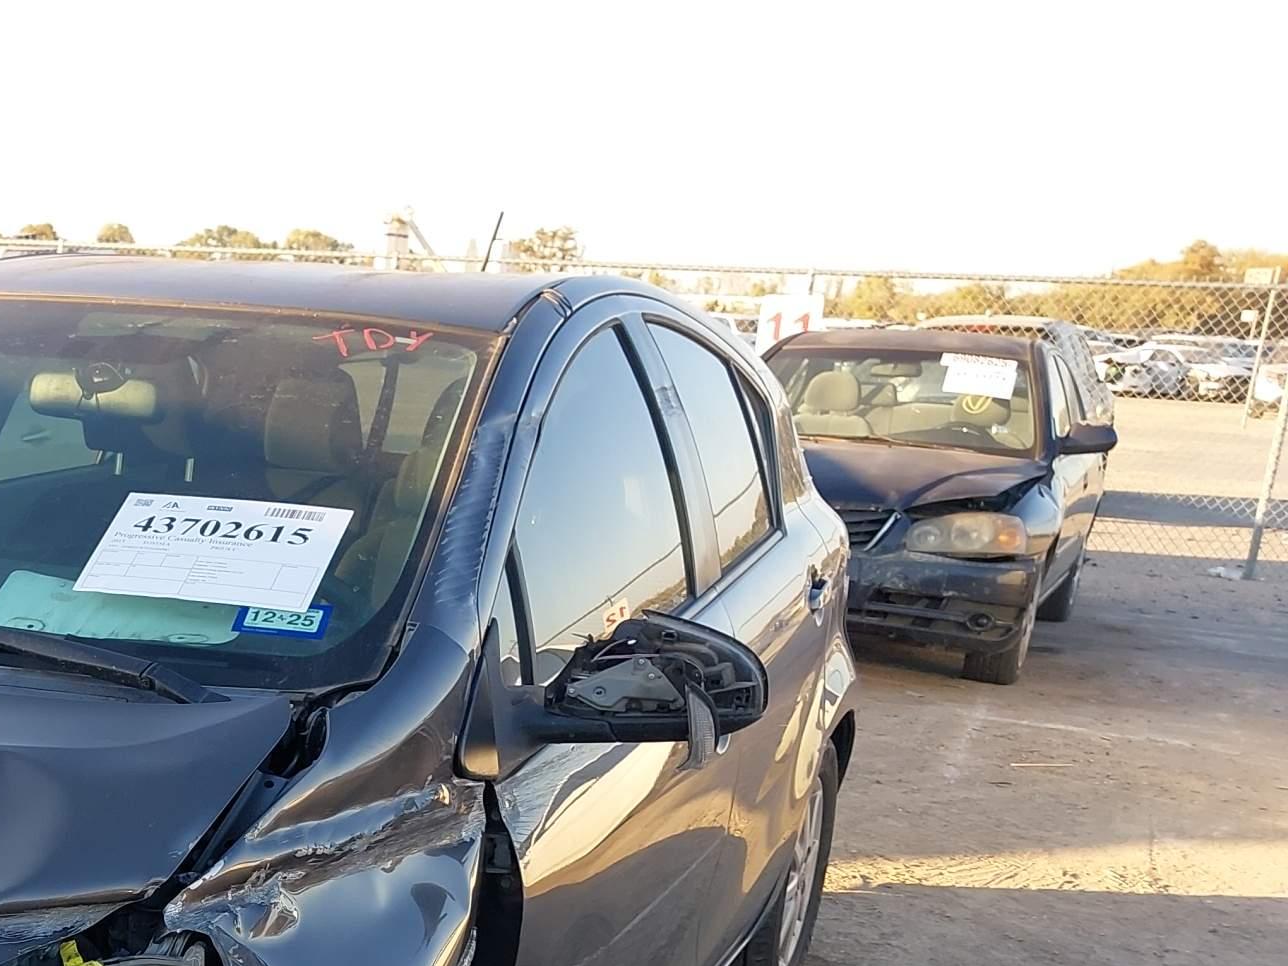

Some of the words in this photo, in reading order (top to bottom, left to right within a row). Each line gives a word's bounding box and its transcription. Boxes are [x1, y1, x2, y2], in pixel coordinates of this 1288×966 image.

[114, 531, 166, 541] Progressive
[167, 535, 207, 545] Casualty
[208, 538, 254, 548] Insurance
[133, 515, 314, 546] 43702615
